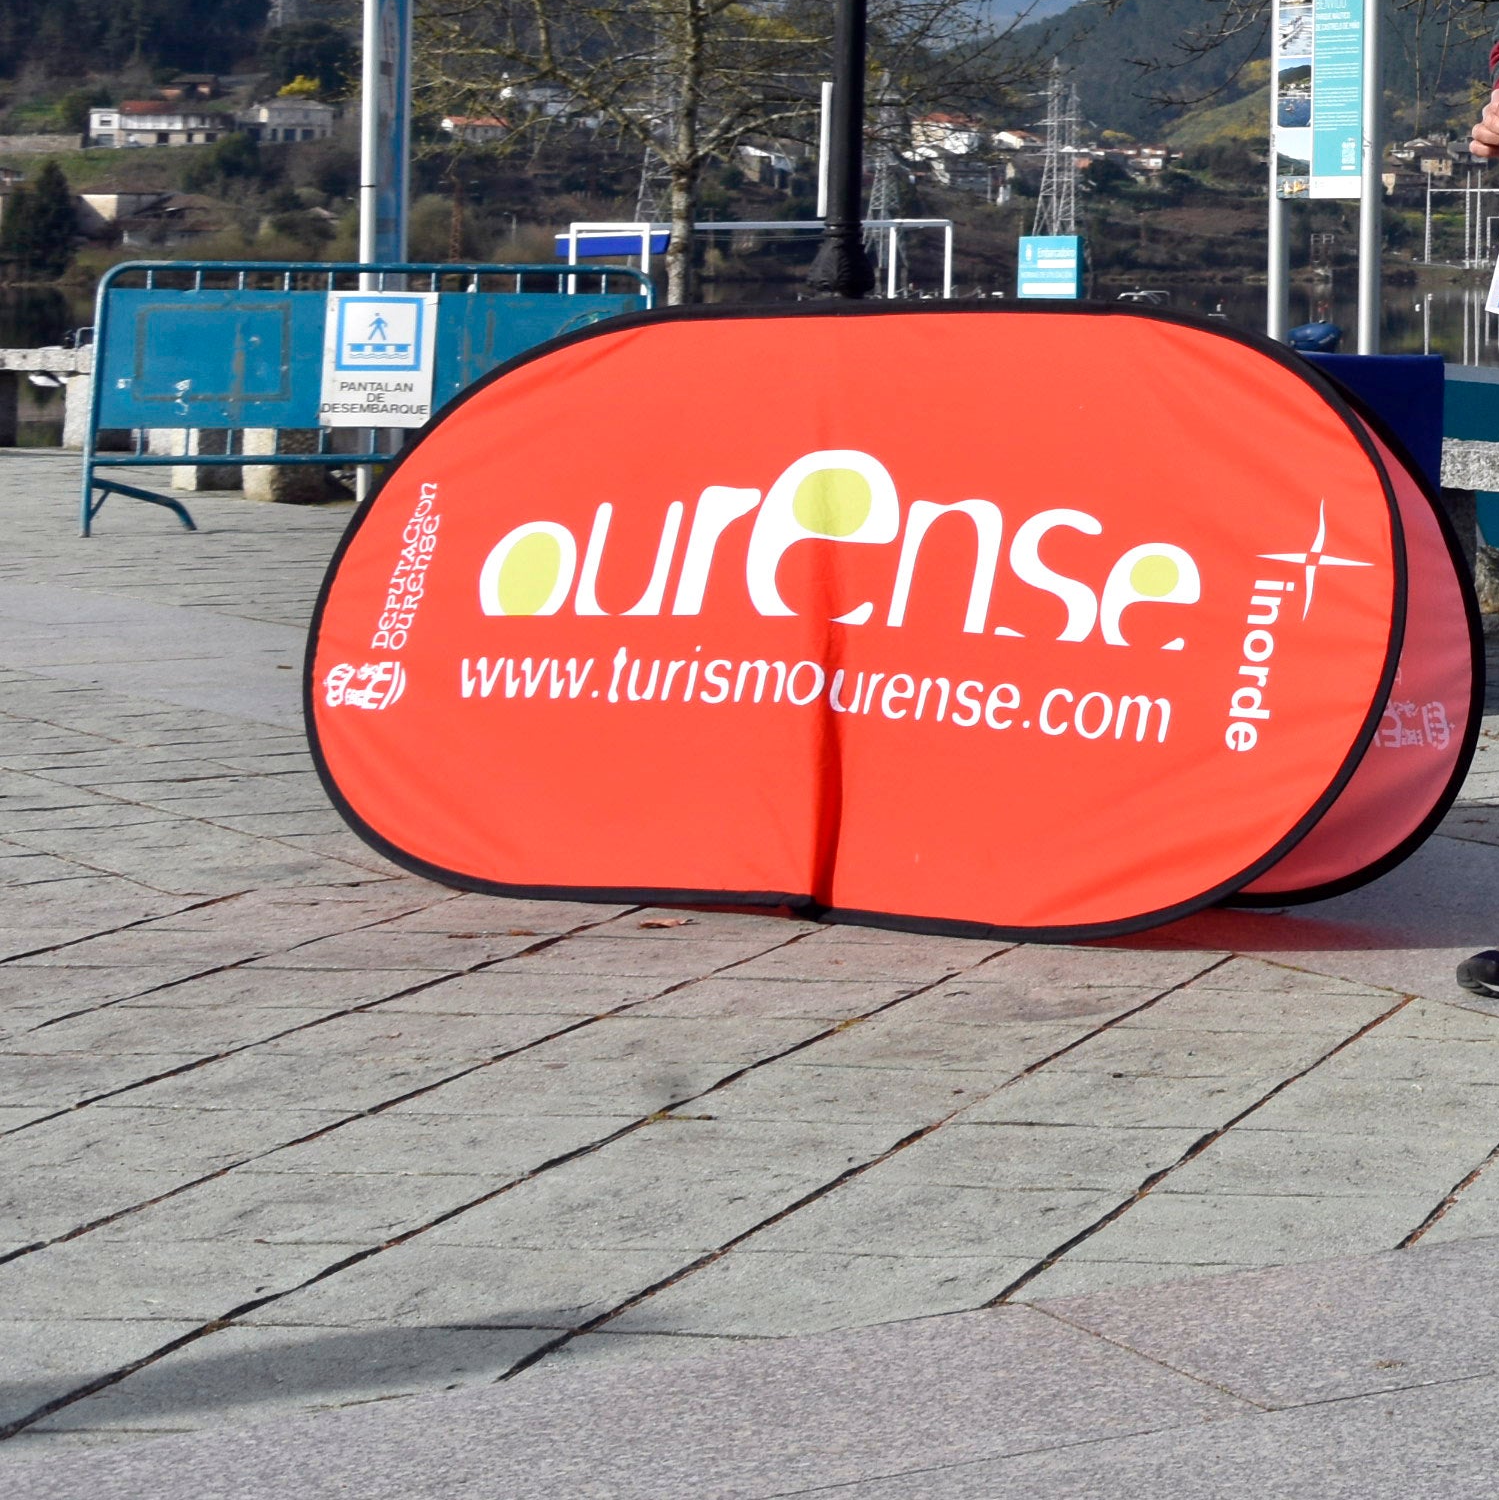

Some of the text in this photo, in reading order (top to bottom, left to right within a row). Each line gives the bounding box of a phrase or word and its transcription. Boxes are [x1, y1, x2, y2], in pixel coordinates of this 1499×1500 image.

[321, 403, 428, 415] DESEMBARQUE
[340, 381, 414, 392] PANTALAN
[366, 393, 385, 403] DE
[478, 447, 1203, 650] ourense
[459, 643, 1173, 743] www.turismourense.com
[1224, 576, 1299, 754] inorde
